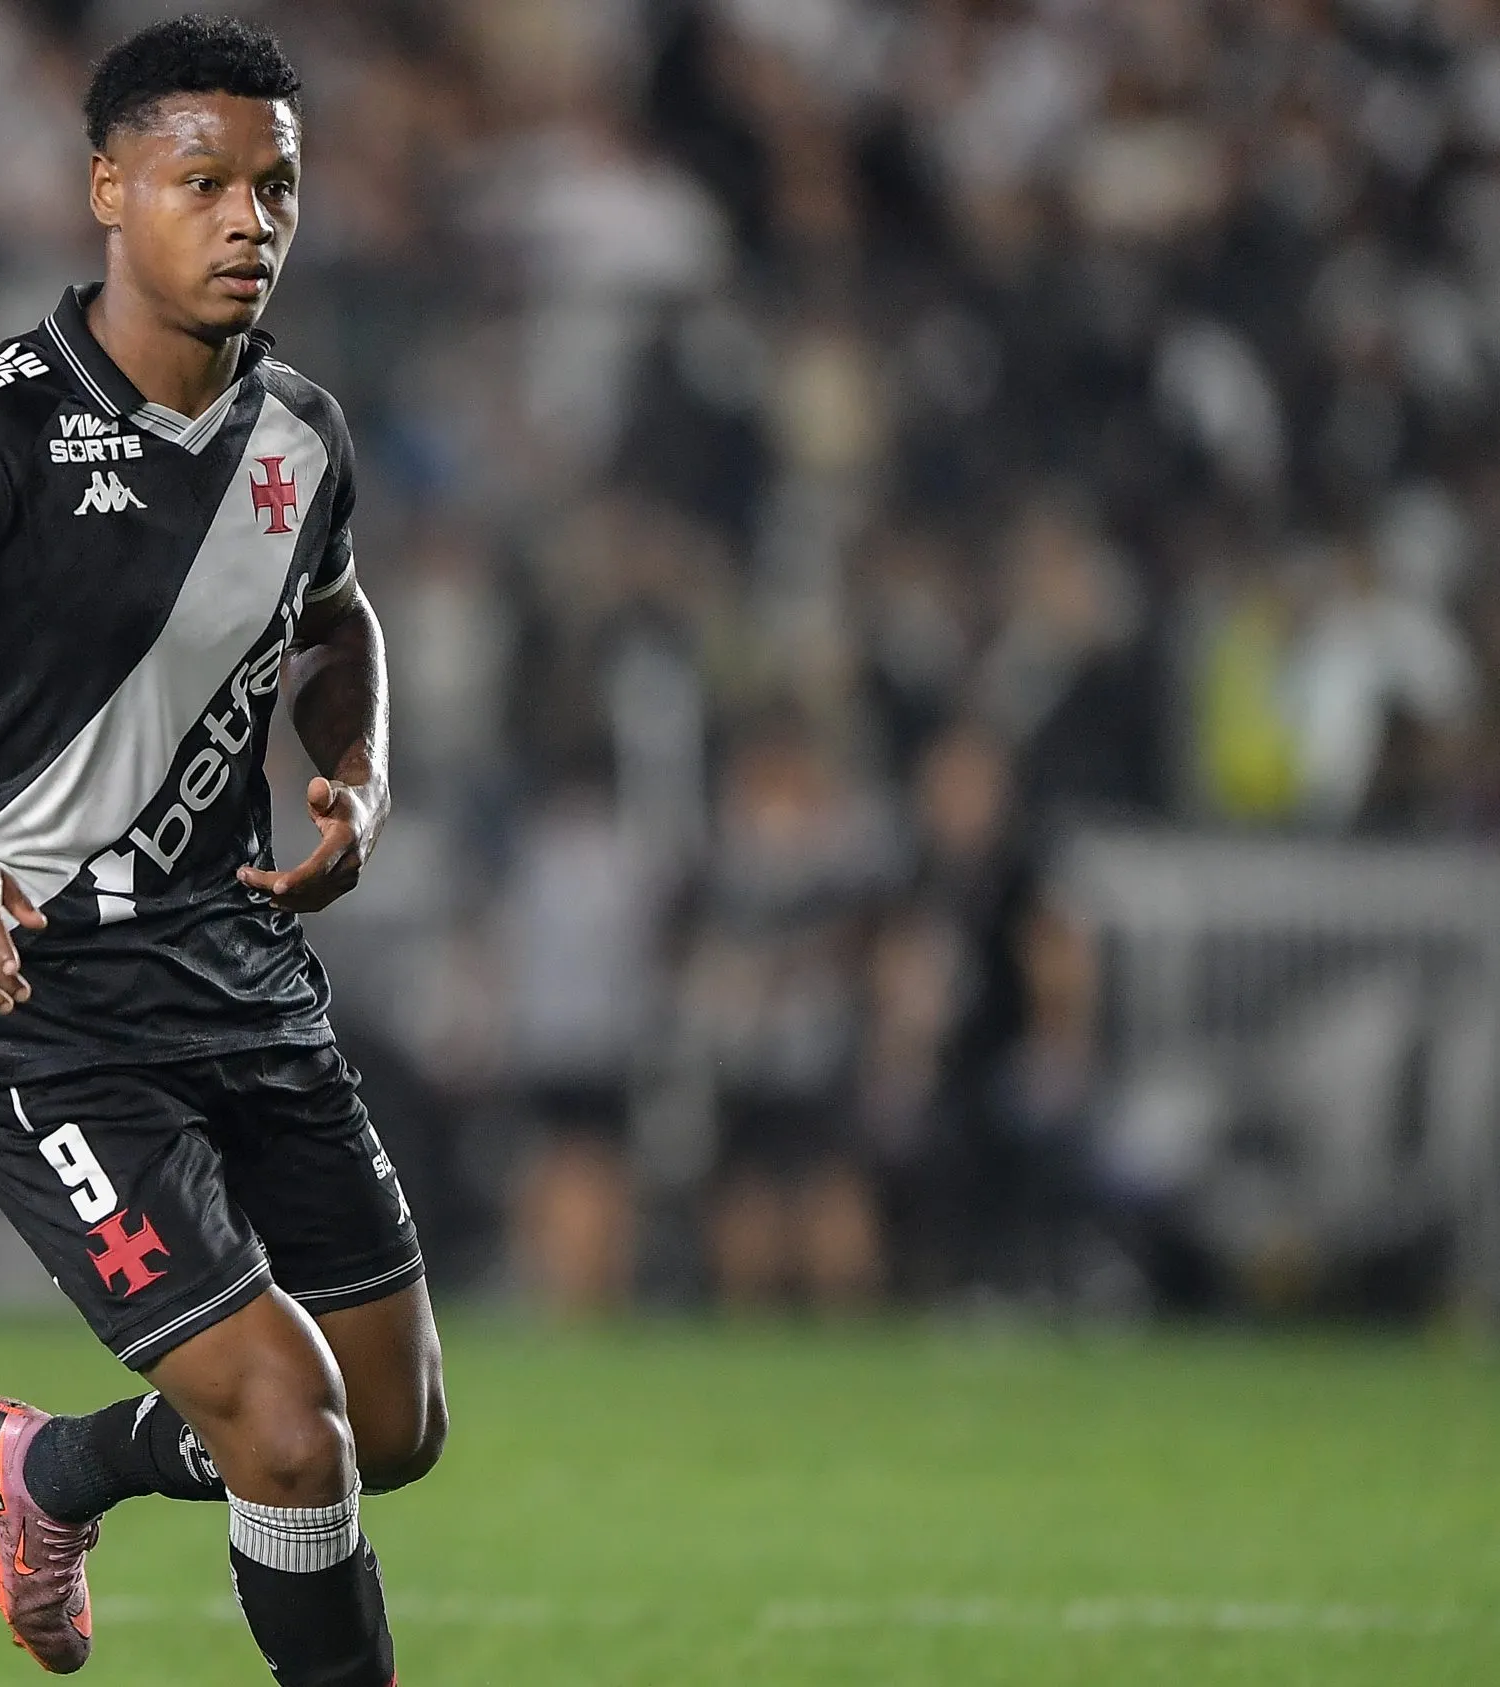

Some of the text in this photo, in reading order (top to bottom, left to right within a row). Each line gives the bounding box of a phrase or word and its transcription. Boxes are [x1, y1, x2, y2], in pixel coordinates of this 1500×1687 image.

[49, 435, 143, 462] SORTE
[59, 413, 119, 438] VIVA
[129, 572, 310, 875] betfair
[38, 1122, 118, 1224] 9
